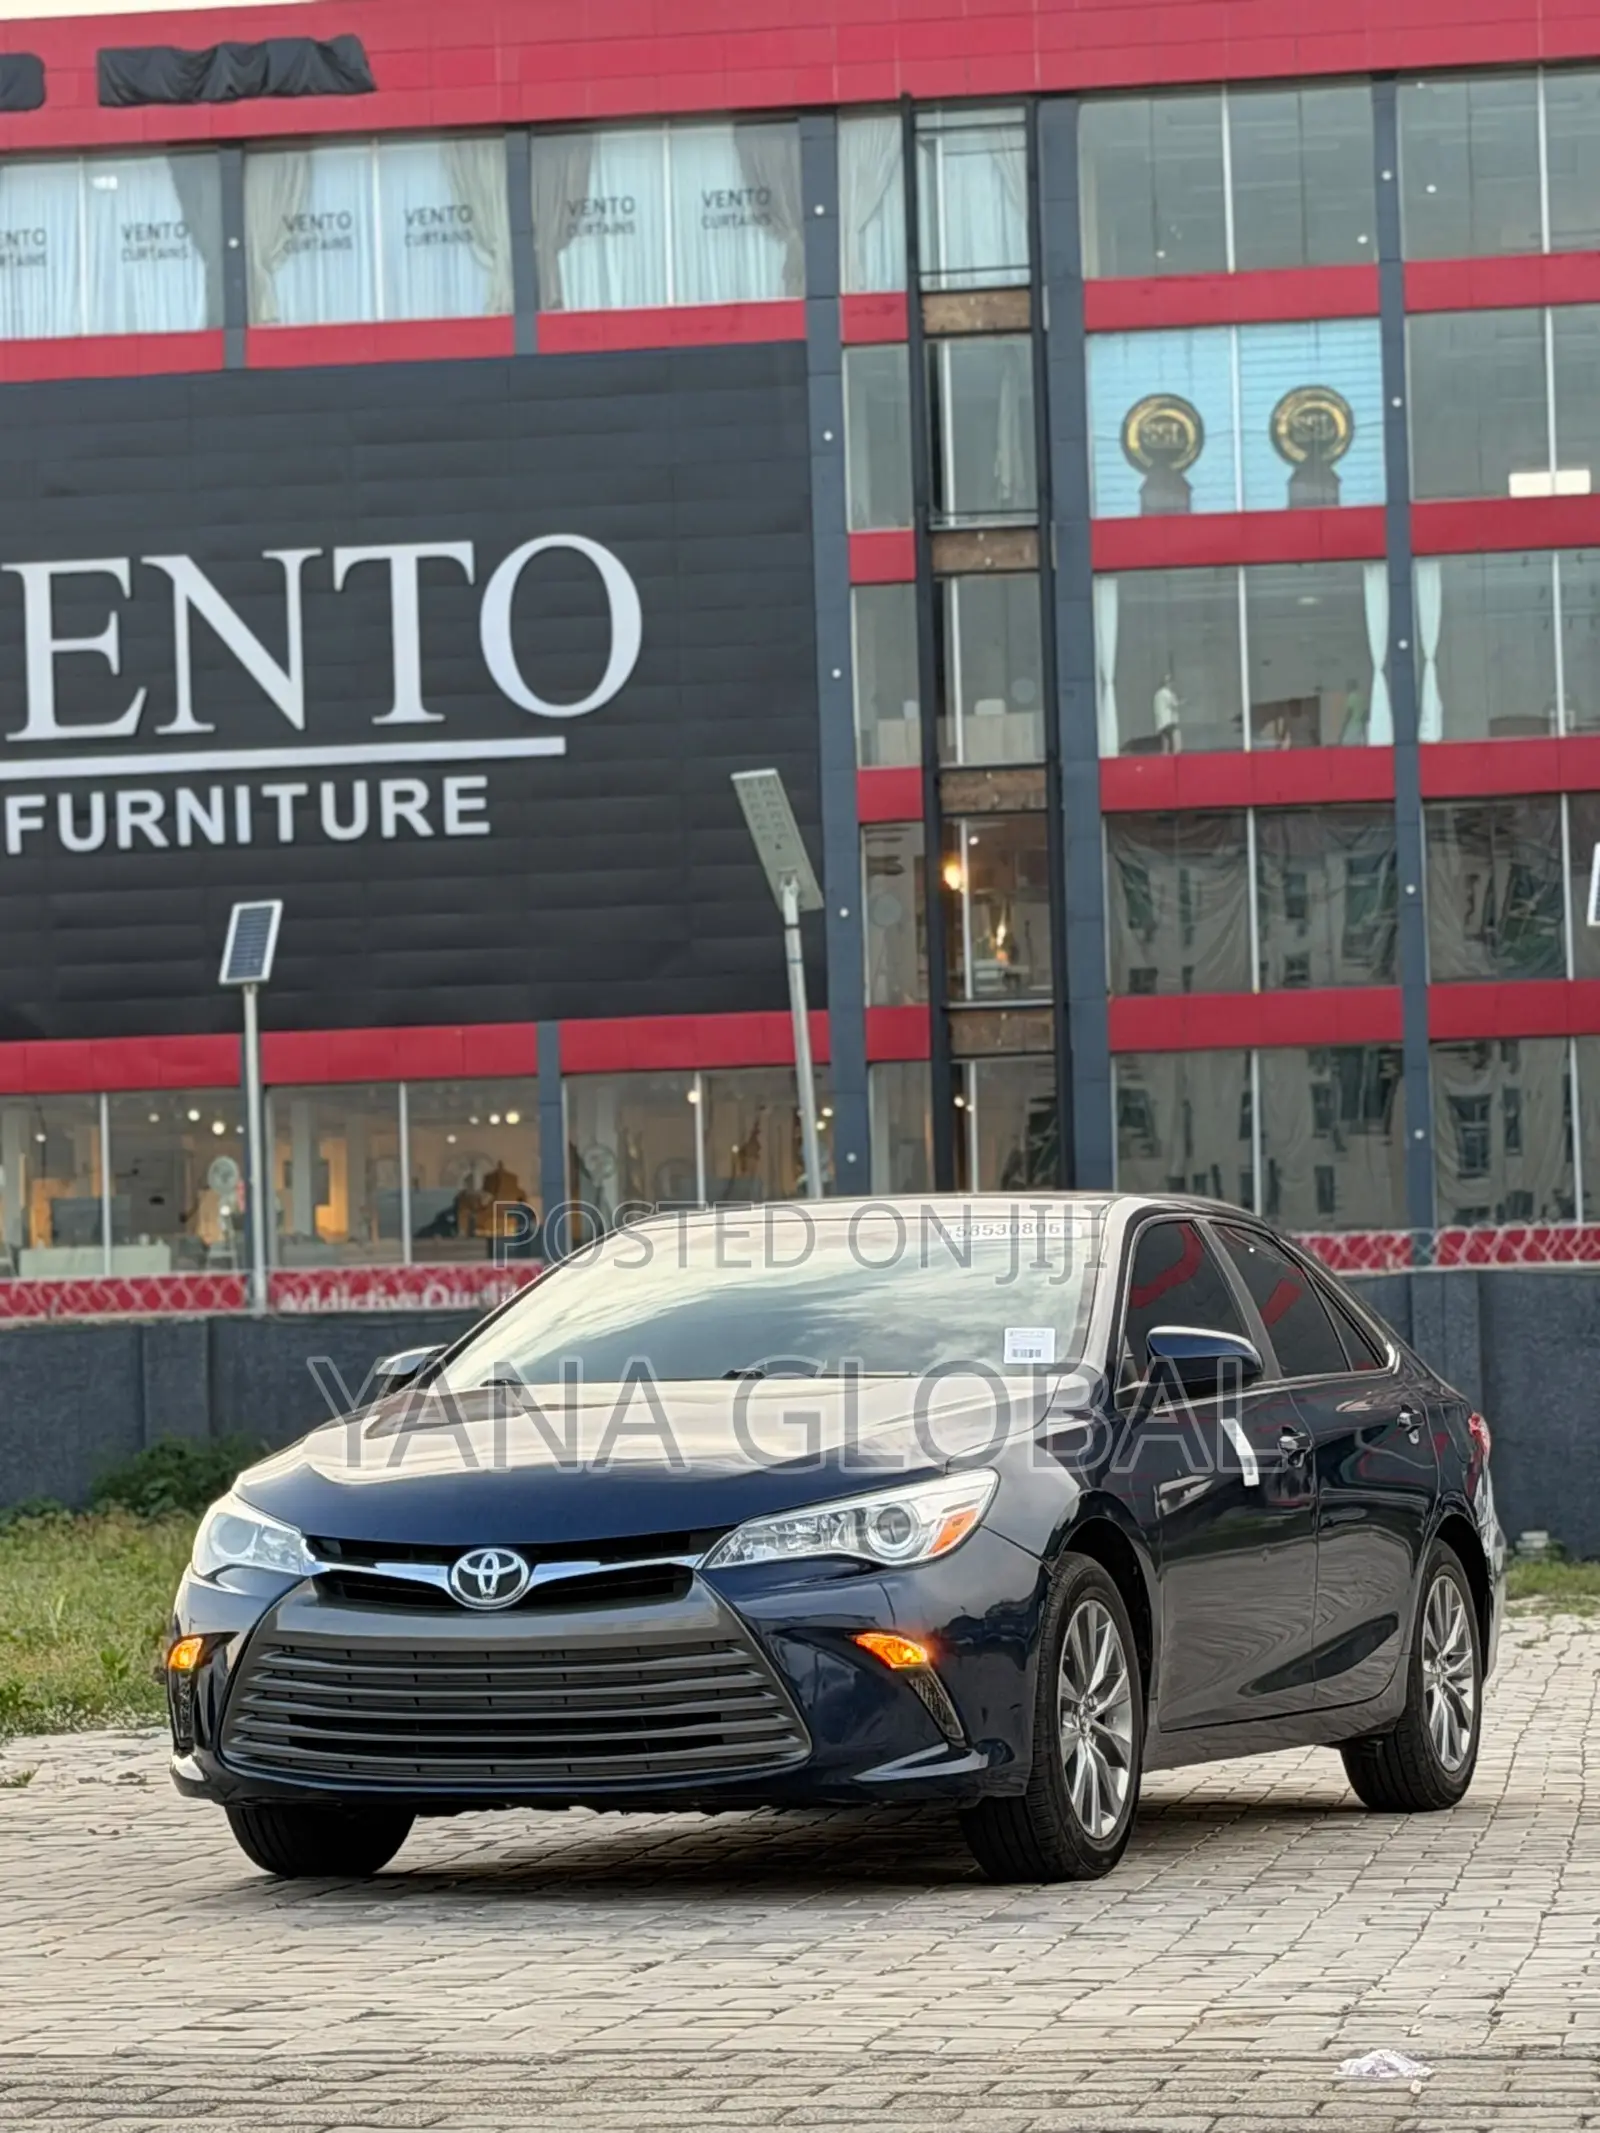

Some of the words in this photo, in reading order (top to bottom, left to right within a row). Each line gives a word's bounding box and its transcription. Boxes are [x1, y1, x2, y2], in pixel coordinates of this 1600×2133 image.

[567, 196, 636, 216] VENTO
[701, 186, 772, 209] VENTO
[282, 210, 353, 233] VENTO
[403, 204, 474, 227] VENTO
[121, 221, 190, 242] VENTO
[2, 533, 643, 742] ENTO
[6, 776, 491, 855] FURNITURE
